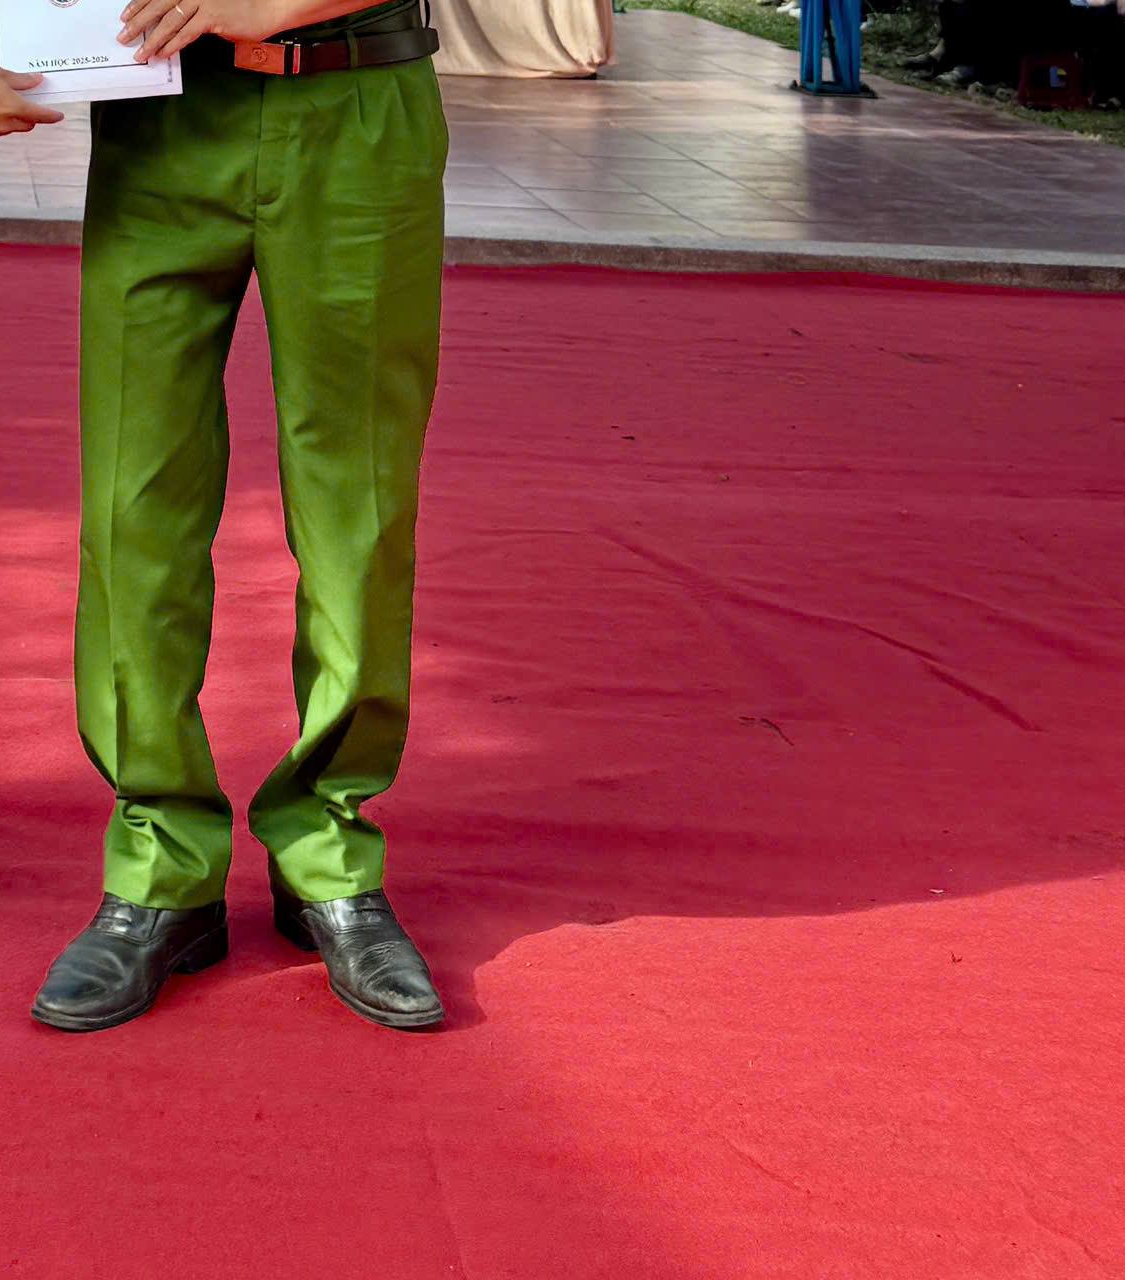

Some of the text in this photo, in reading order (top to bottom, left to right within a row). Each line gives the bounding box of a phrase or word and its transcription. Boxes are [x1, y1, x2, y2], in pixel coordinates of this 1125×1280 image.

[28, 55, 109, 68] NĂM HỌC 2025-2026
